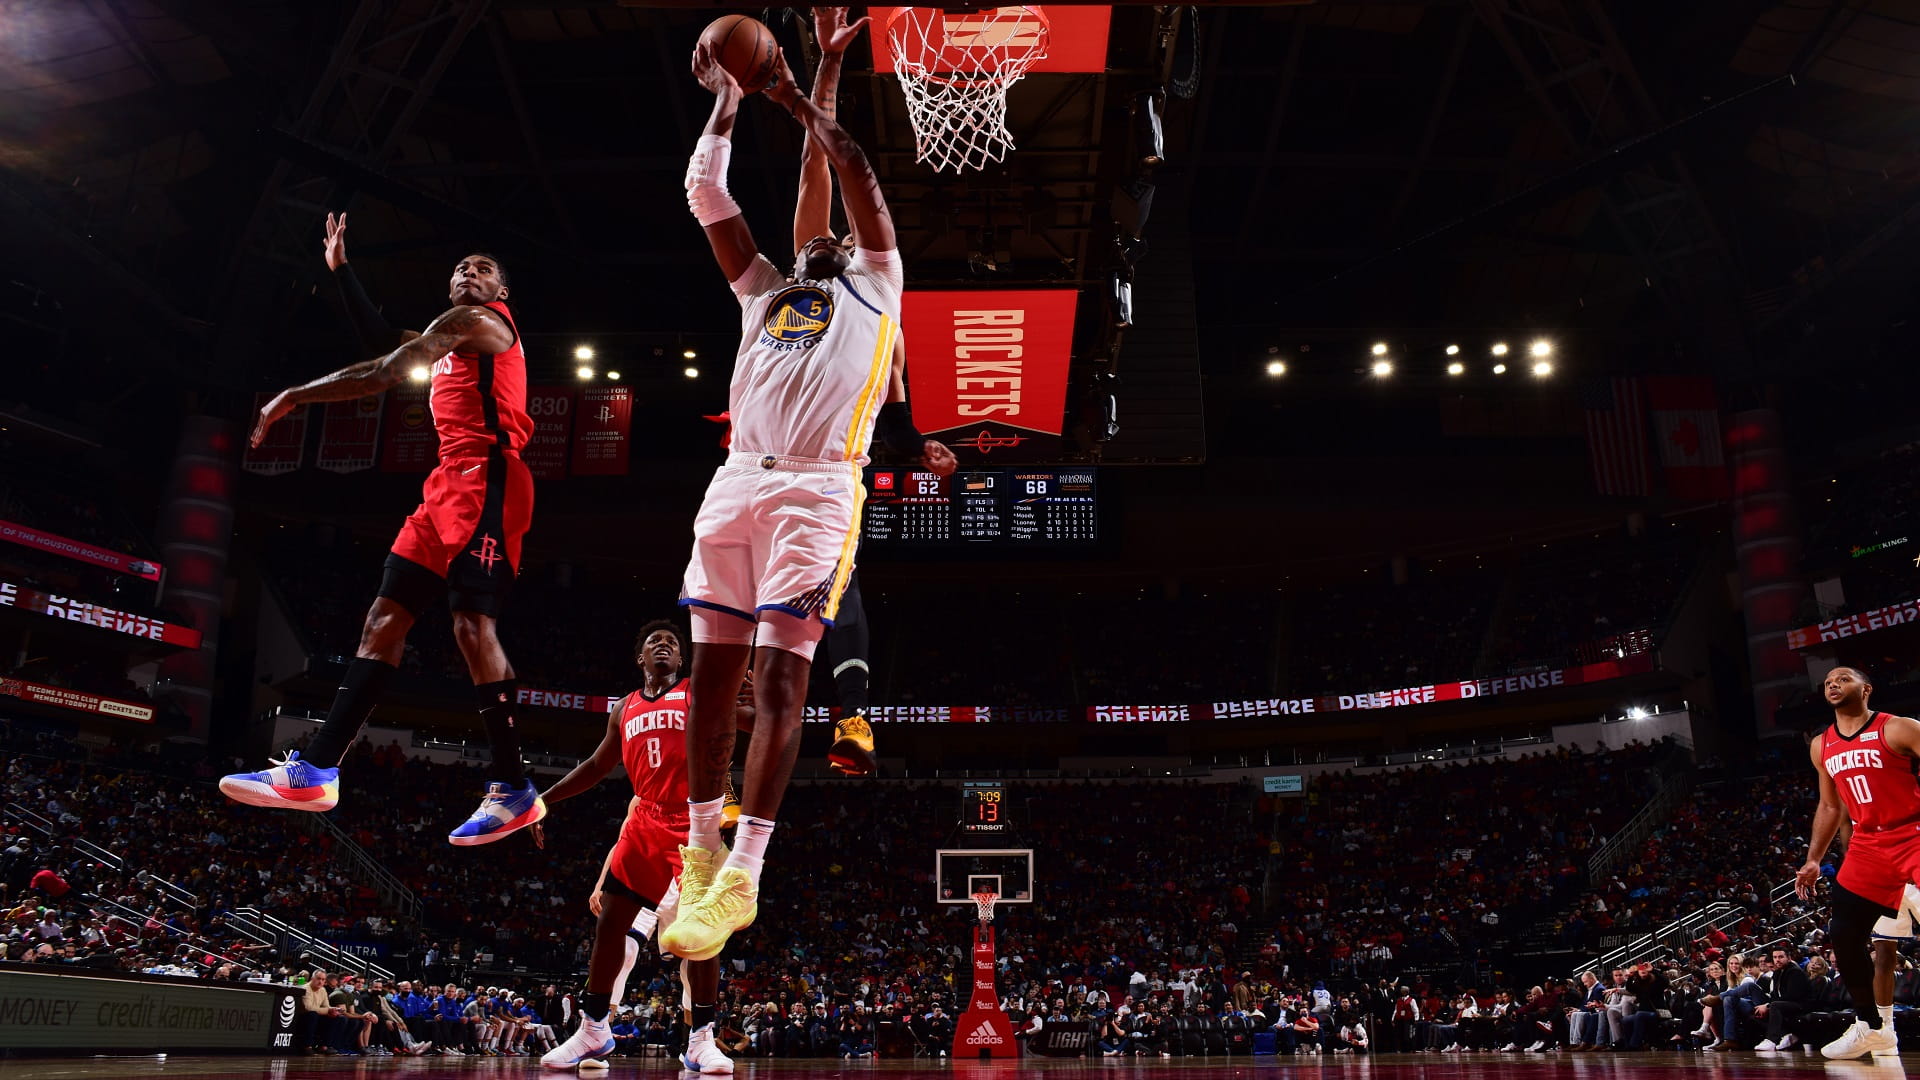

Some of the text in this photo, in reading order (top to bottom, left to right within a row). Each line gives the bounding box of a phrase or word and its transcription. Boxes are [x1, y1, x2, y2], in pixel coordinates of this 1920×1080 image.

[810, 300, 824, 317] 5
[953, 309, 1025, 416] ROCKETS
[918, 481, 939, 495] 62
[1026, 480, 1047, 494] 68
[3, 527, 17, 536] OF
[17, 530, 36, 543] THE
[36, 533, 81, 554] HOUSTON
[80, 546, 120, 565] ROCKETS
[27, 685, 56, 697] BECOME
[63, 692, 80, 701] KIDS
[1459, 670, 1564, 699] DEFENSE
[33, 693, 63, 705] MEMBER
[103, 703, 149, 717] ROCKETS.COM
[625, 709, 686, 742] ROCKETS
[646, 737, 662, 768] 8
[1825, 749, 1883, 779] ROCKETS
[977, 791, 1001, 802] 7:09
[1845, 774, 1873, 805] 10
[979, 803, 998, 821] 13
[340, 944, 378, 957] ULTRA
[0, 992, 265, 1032] MONEY credit karma MONEY
[273, 1033, 293, 1047] AT&T
[966, 1036, 1003, 1045] adidas
[1048, 1031, 1089, 1049] LIGHT
